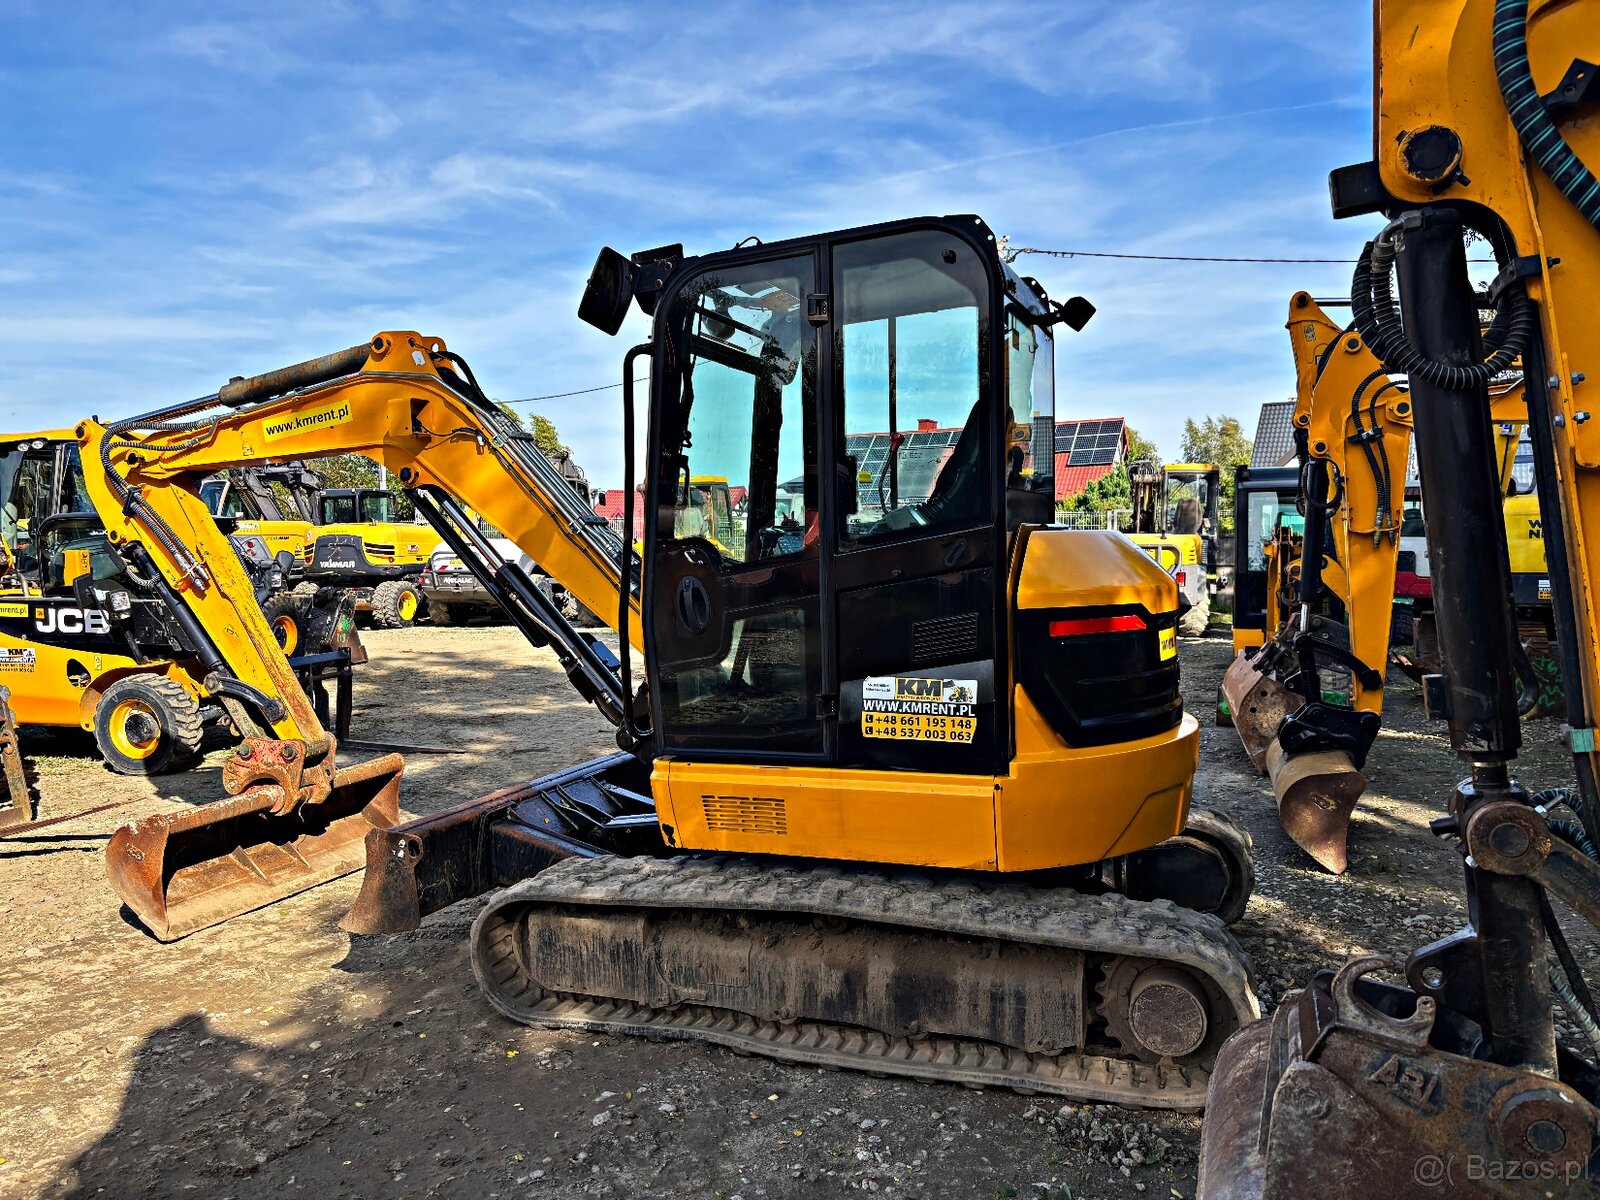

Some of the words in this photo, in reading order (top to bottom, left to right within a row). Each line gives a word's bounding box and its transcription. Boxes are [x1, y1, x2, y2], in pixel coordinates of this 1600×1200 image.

[265, 405, 349, 435] www.kmrent.pl
[319, 560, 356, 568] YANMAR
[35, 607, 110, 634] JCB
[897, 679, 941, 696] KM
[863, 700, 976, 717] WWW.KMRENT.PL
[876, 716, 897, 725] +48
[900, 716, 920, 726] 661
[925, 717, 946, 728] 195
[951, 719, 972, 729] 148
[876, 727, 897, 737] +48
[900, 728, 920, 738] 537
[925, 729, 946, 739] 003
[950, 731, 971, 741] 063
